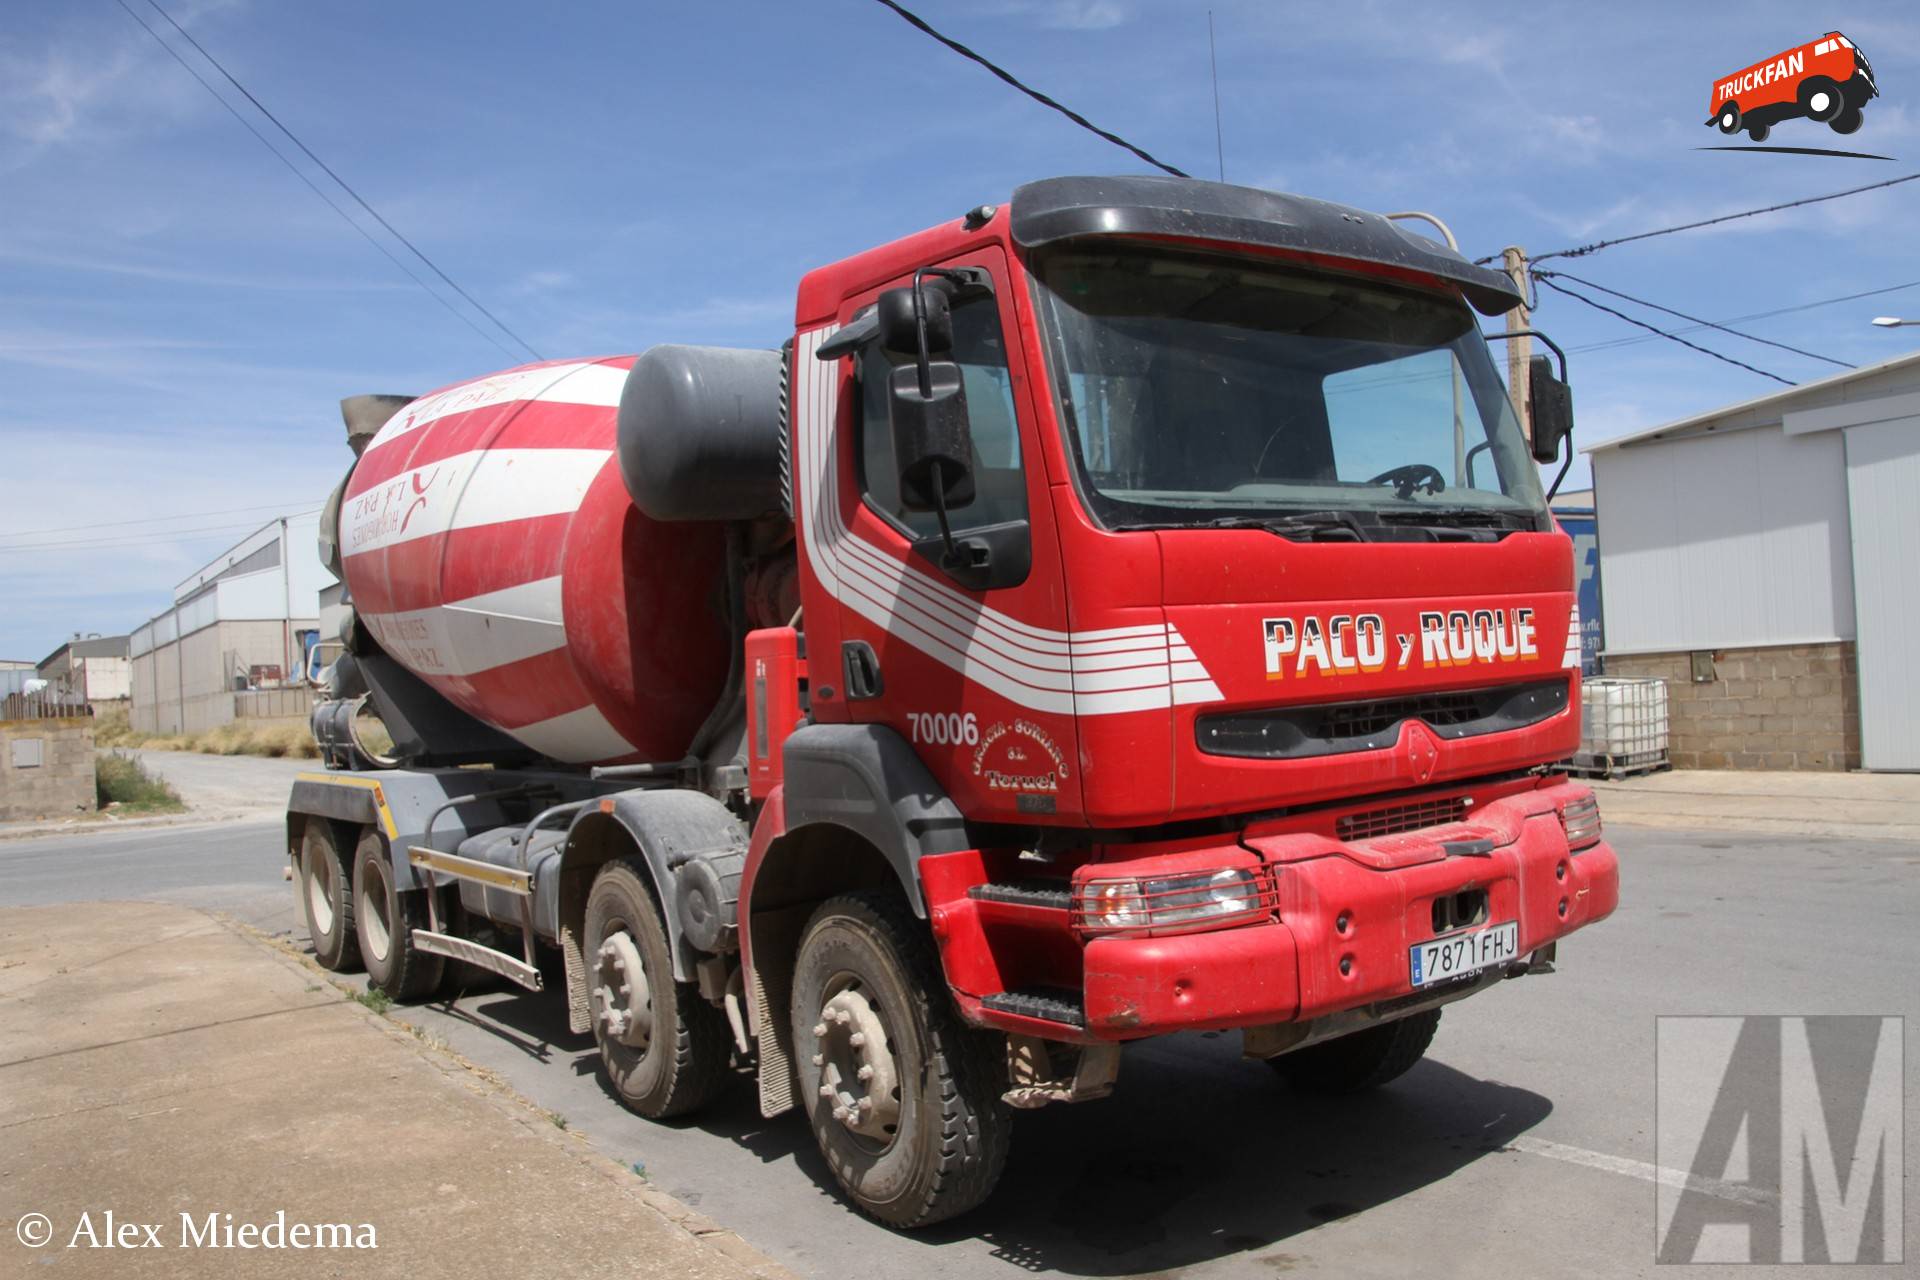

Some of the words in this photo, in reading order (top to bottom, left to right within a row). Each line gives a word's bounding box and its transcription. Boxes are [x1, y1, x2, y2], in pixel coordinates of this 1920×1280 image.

[1262, 614, 1387, 680] PACO
[1396, 633, 1415, 671] y
[1419, 608, 1539, 669] ROQUE
[906, 712, 979, 746] 70006
[984, 770, 1058, 790] Teruel
[1428, 935, 1475, 977] 7871
[1482, 928, 1515, 962] FHJ
